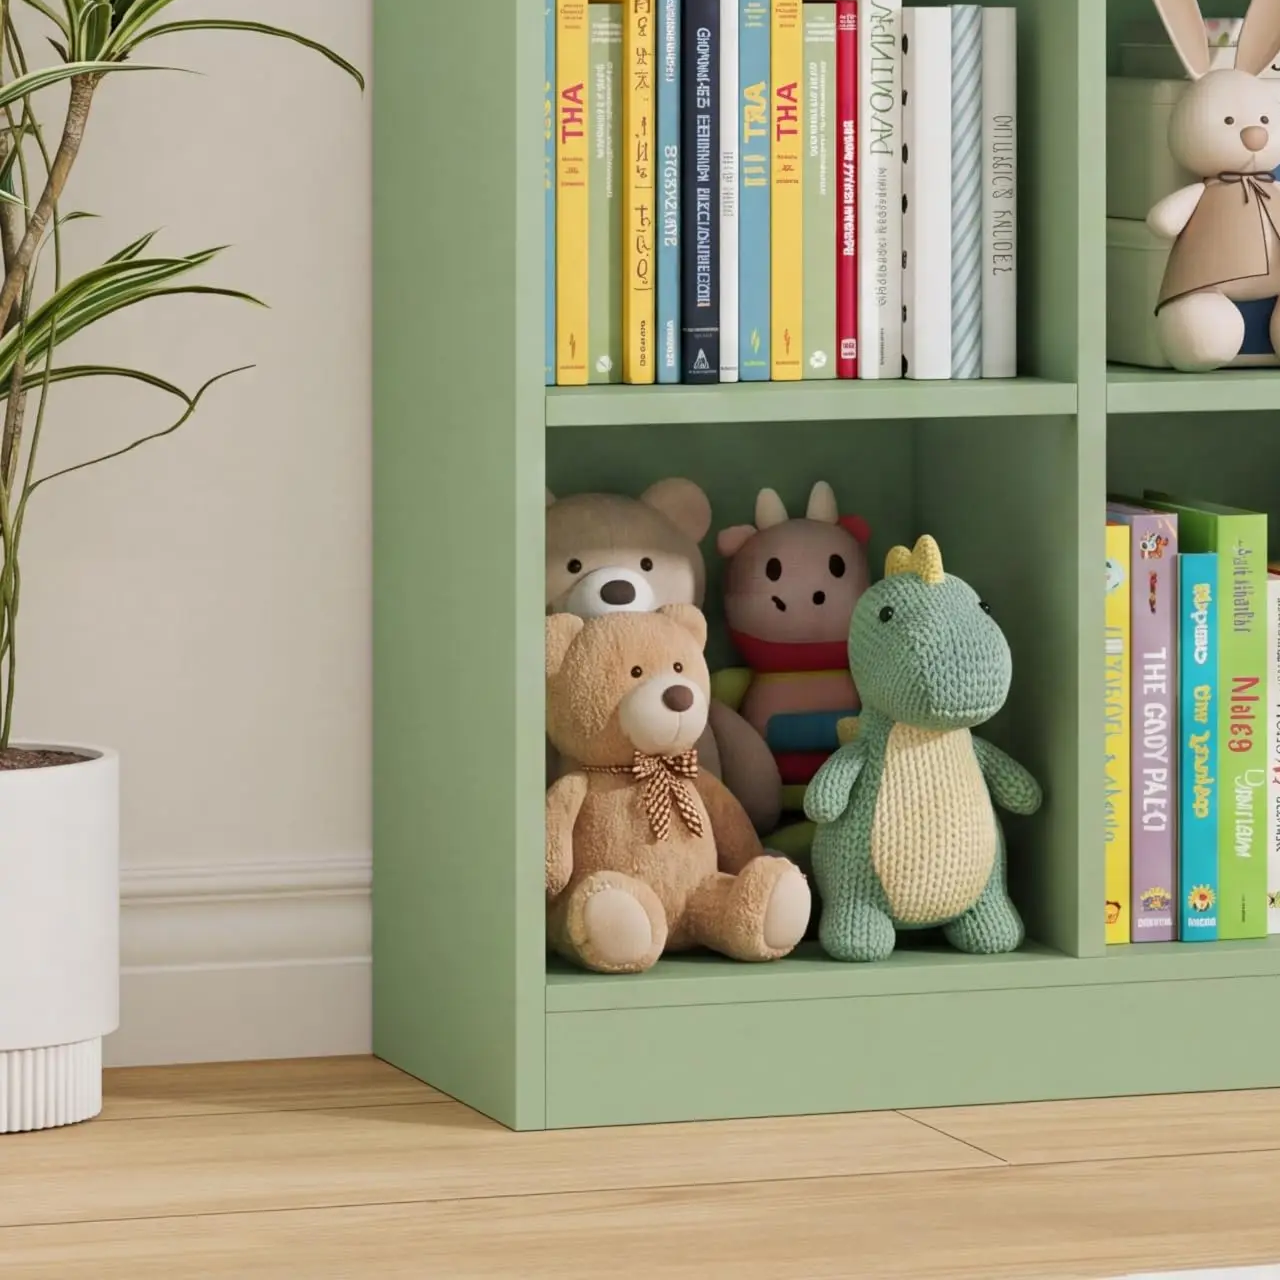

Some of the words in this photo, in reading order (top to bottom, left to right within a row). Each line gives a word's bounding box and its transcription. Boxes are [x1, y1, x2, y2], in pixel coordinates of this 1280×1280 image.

[562, 83, 584, 144] THA
[776, 82, 798, 142] THA
[1143, 647, 1167, 694] THE
